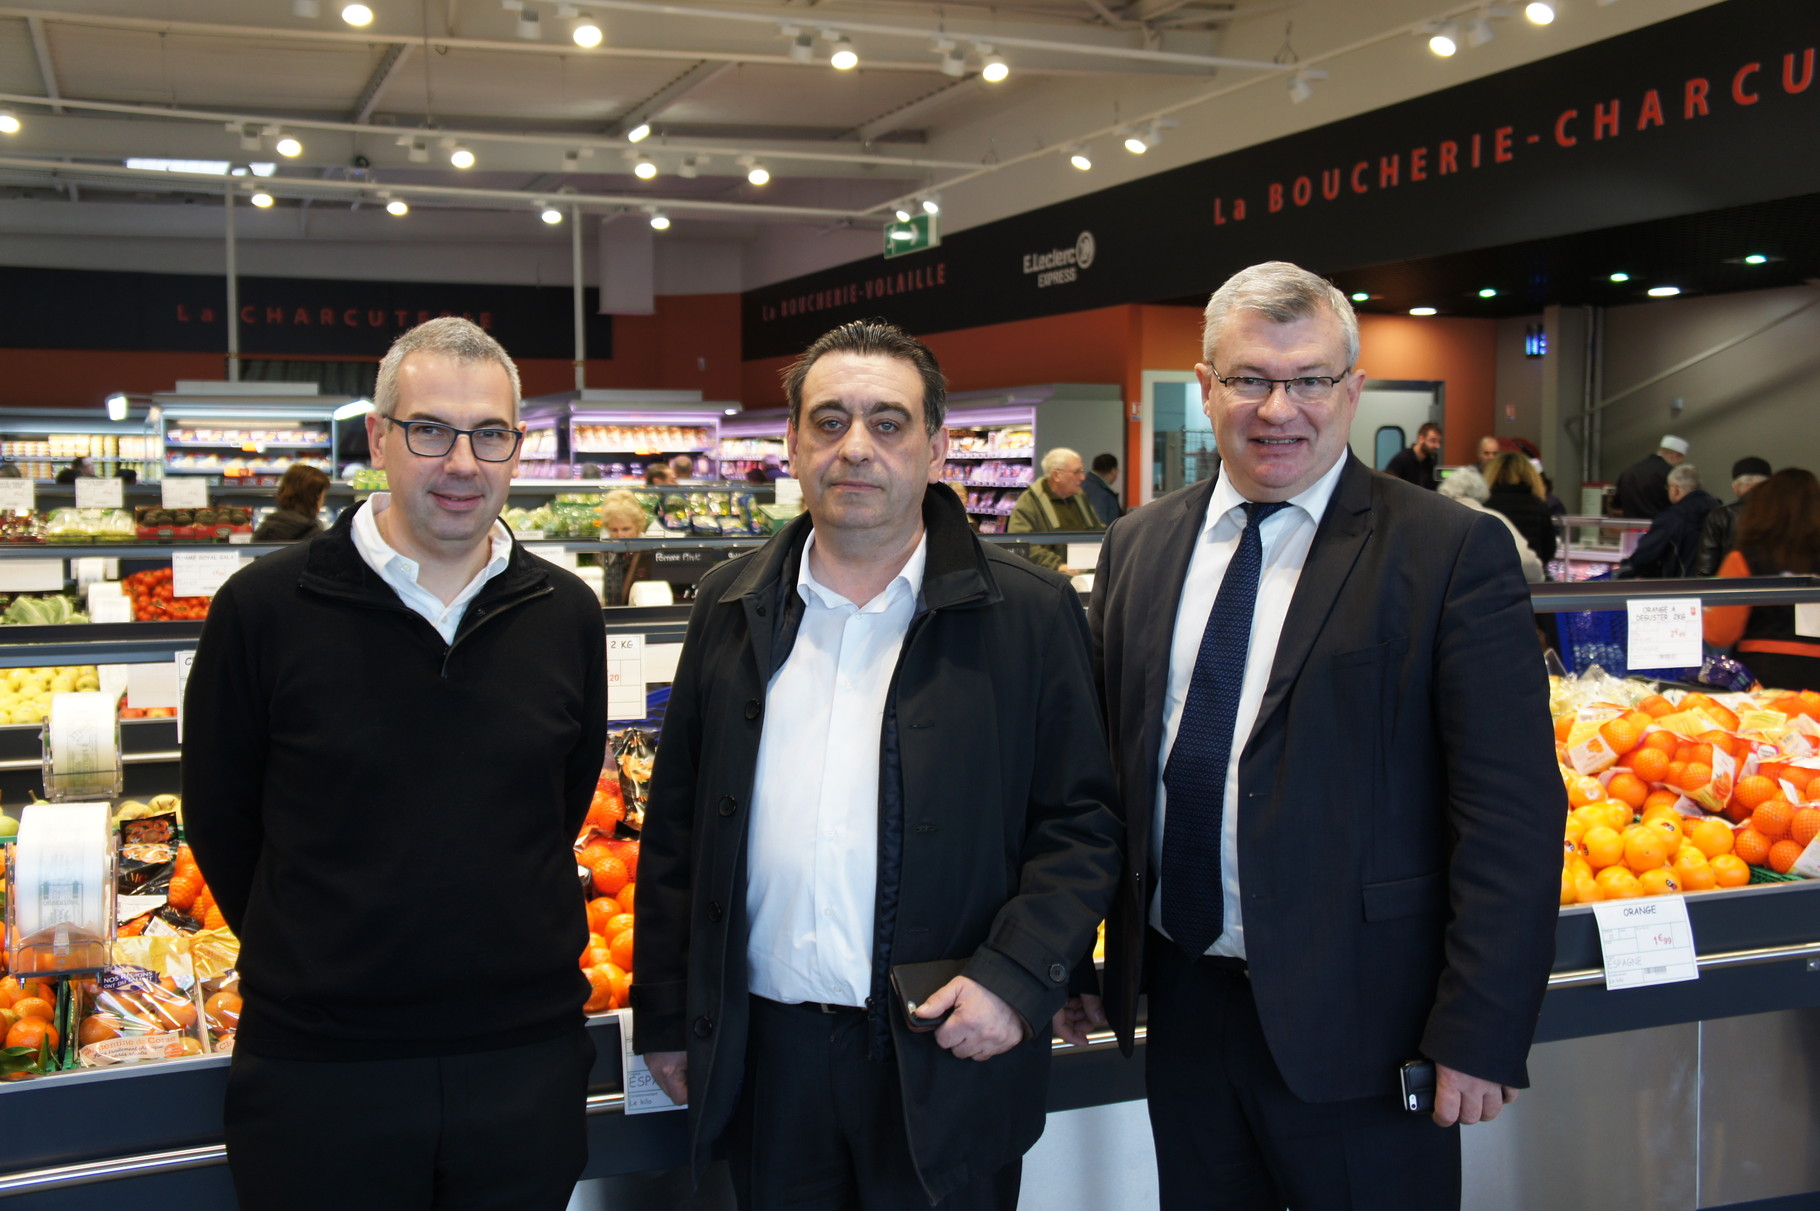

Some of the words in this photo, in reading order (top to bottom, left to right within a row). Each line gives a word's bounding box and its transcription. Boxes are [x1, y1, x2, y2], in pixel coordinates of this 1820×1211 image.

[1213, 196, 1247, 226] La
[1267, 46, 1818, 214] BOUCHERIE-CHARCU
[1022, 247, 1077, 274] E.Leclerc
[1037, 267, 1078, 288] EXPRESS
[761, 304, 777, 322] La
[780, 263, 947, 318] BOUCHERIE-VOLAILLE
[176, 303, 216, 324] La
[609, 641, 617, 649] 2
[620, 640, 634, 649] KG
[1623, 905, 1657, 917] ORANGE
[1652, 933, 1673, 946] 1€99
[1607, 956, 1643, 969] ESPAGNE
[103, 975, 120, 984] NOS
